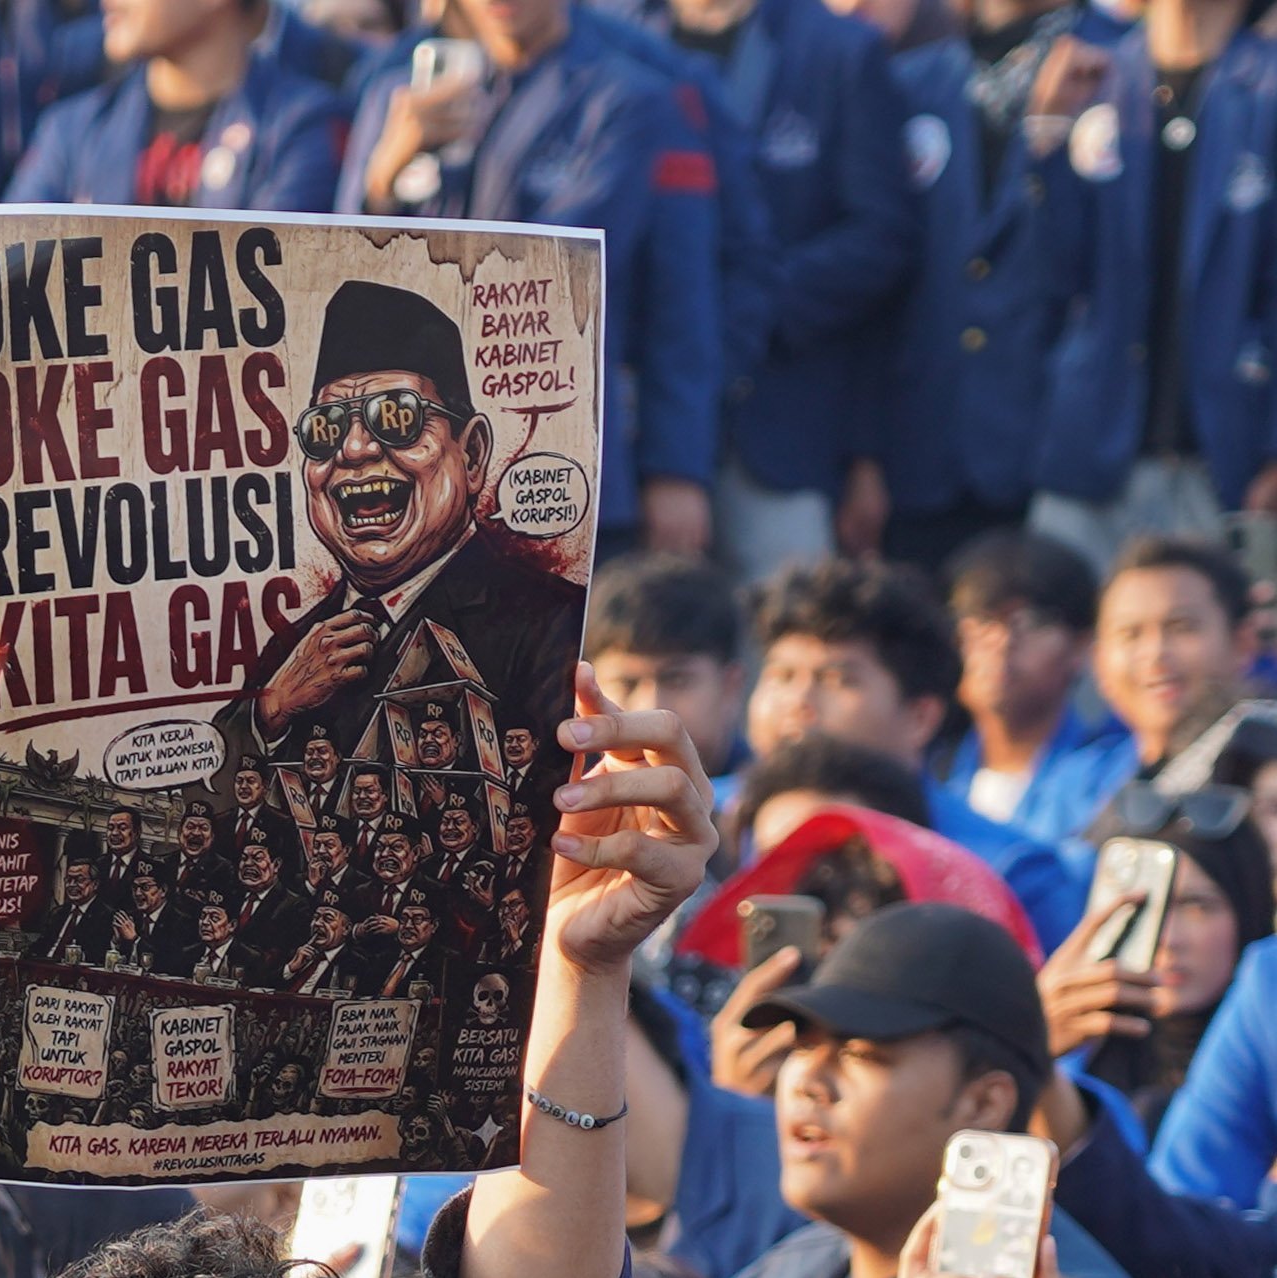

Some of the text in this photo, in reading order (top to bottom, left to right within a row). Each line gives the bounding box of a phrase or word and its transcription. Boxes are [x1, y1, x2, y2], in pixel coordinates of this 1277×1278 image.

[130, 227, 286, 354] GAS
[472, 279, 553, 310] RAKYAT
[481, 310, 552, 340] BAYAR
[475, 340, 563, 368] KABINET
[481, 366, 575, 398] GASPOL!
[140, 351, 290, 475] GAS
[380, 399, 413, 436] Rp
[309, 414, 340, 447] Rp
[508, 466, 575, 488] (KABINET
[515, 486, 572, 505] GASPOL
[510, 505, 578, 525] KORUPSI!)
[427, 703, 443, 719] Rp
[132, 727, 194, 748] KITA KERJA
[312, 725, 327, 738] Rp
[395, 721, 411, 749] Rp
[477, 718, 495, 750] Rp
[115, 740, 215, 766] UNTUK INDONESIA
[114, 755, 220, 783] (TAPI DULUAN KITA)
[241, 756, 256, 770] Rp
[192, 803, 207, 816] Rp
[448, 792, 465, 808] Rp
[513, 802, 529, 817] Rp
[321, 815, 337, 829] Rp
[385, 814, 403, 831] Rp
[251, 827, 266, 843] Rp
[138, 860, 153, 875] Rp
[209, 890, 223, 905] Rp
[323, 890, 339, 905] Rp
[410, 888, 426, 904] Rp
[34, 996, 104, 1016] DARI RAKYAT
[340, 1007, 398, 1023] BBM NAIK
[32, 1013, 104, 1032] OLEH RAKYAT
[160, 1016, 224, 1036] KABINET
[336, 1020, 400, 1036] PAJAK NAIK
[51, 1030, 80, 1047] TAPI
[332, 1034, 409, 1050] GAJI STAGNAN
[457, 1028, 519, 1046] BERSATU
[164, 1037, 222, 1057] GASPOL
[452, 1046, 520, 1064] KITA GAS!
[41, 1048, 88, 1066] UNTUK
[337, 1050, 387, 1066] MENTERI
[22, 1065, 103, 1087] KORUPTOR?
[167, 1057, 221, 1077] RAKYAT
[322, 1066, 402, 1086] FOYA-FOYA!
[452, 1066, 519, 1078] HANCURKAN
[165, 1076, 223, 1100] TEKOR!
[464, 1079, 506, 1091] SISTEM!
[49, 1125, 383, 1156] KITA GAS, KARENA MEREKA TERLALU NYAMAN.
[152, 1152, 266, 1172] #REVOLUSIKITAGAS
